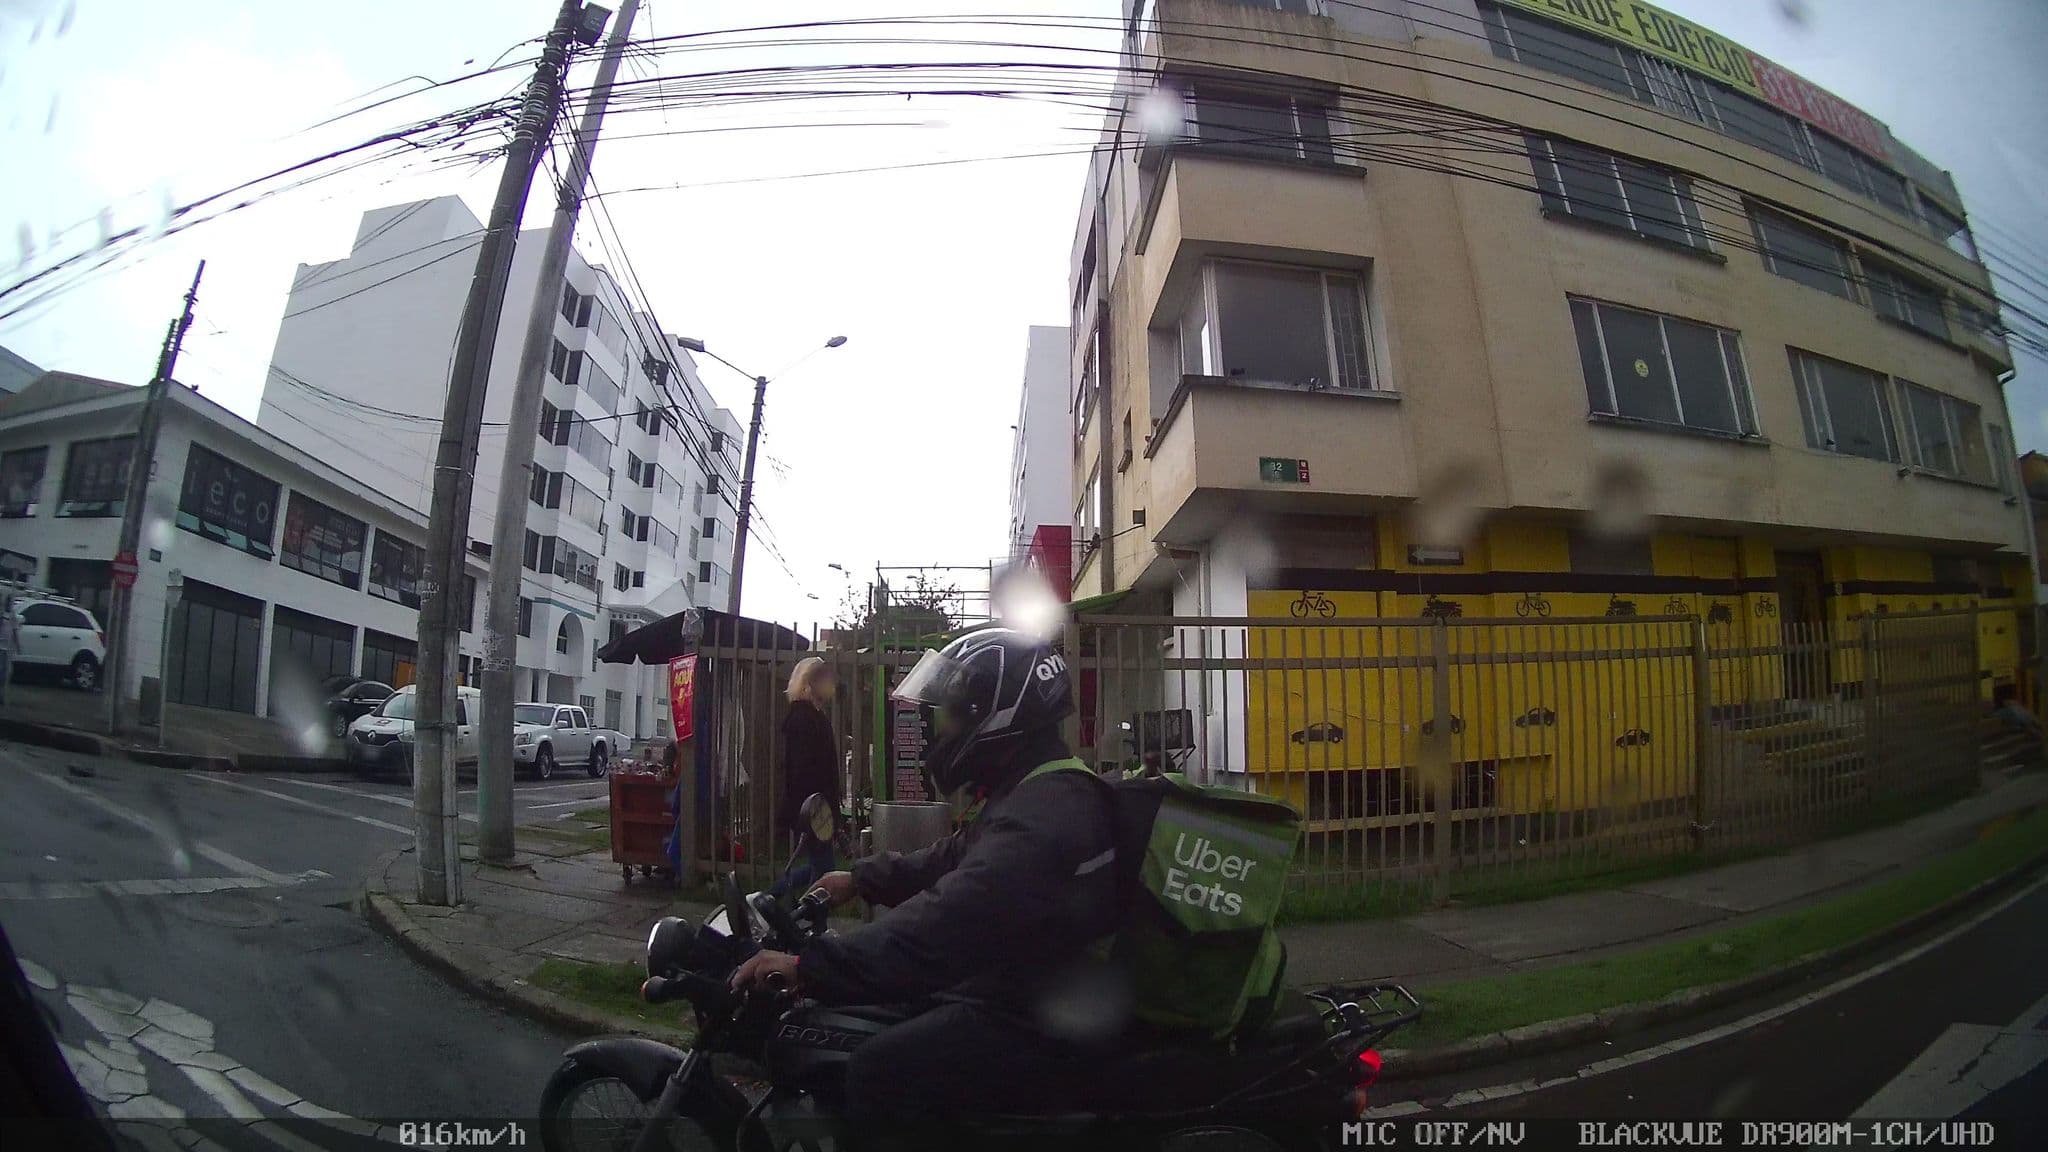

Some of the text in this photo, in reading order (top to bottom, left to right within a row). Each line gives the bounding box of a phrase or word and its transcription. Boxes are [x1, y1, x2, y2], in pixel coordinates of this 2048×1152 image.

[1629, 3, 1756, 88] EDIFICIO
[1174, 832, 1257, 881] Uber
[1162, 867, 1243, 916] Eats
